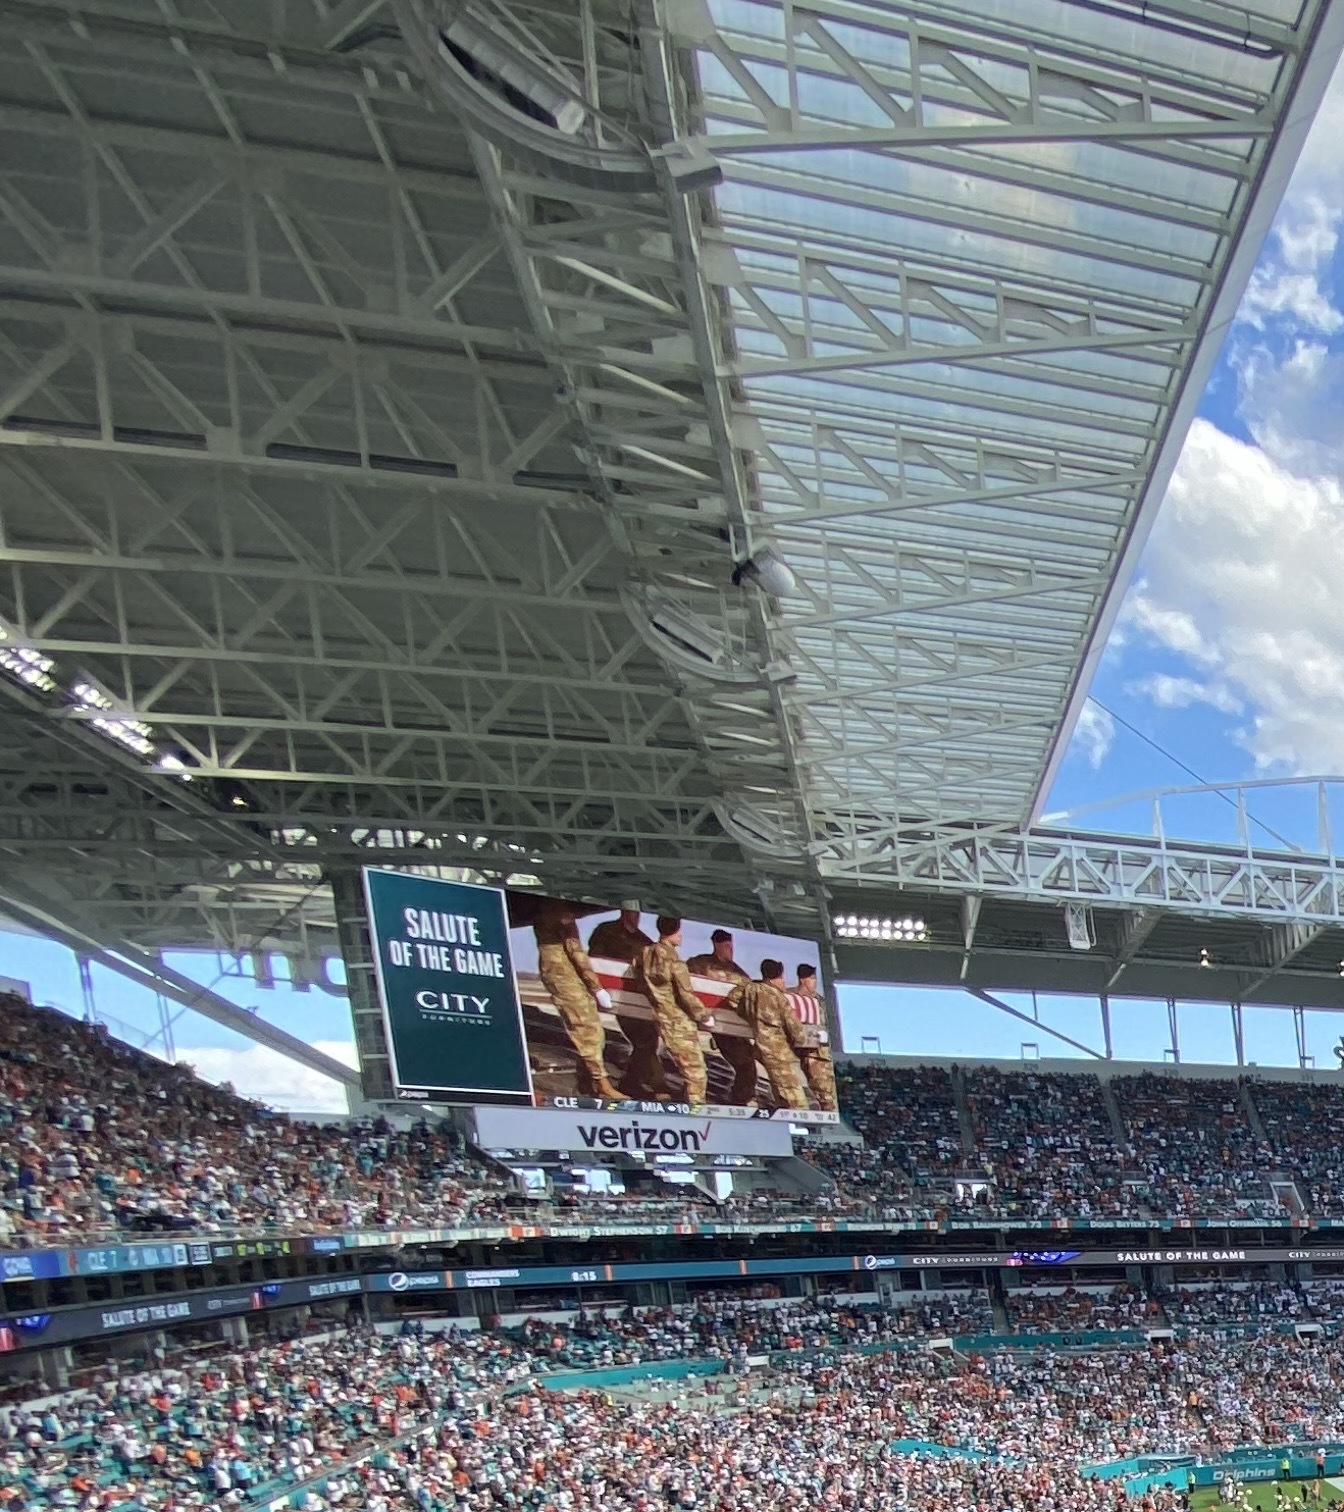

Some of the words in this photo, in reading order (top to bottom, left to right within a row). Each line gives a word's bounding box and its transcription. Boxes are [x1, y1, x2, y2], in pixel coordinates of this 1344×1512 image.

[405, 907, 481, 947] SALUTE
[389, 939, 413, 967] OF
[416, 943, 451, 973] THE
[454, 949, 504, 978] GAME
[416, 990, 491, 1014] CITY
[554, 1096, 578, 1108] CLE
[597, 1100, 603, 1110] 7
[641, 1102, 664, 1113] MIA
[677, 1104, 690, 1115] 10
[577, 1120, 700, 1151] verizon
[1117, 1252, 1162, 1261] SALUTE
[1166, 1252, 1182, 1260] OF
[1186, 1252, 1208, 1260] THE
[1212, 1251, 1245, 1260] GAME
[571, 1271, 597, 1282] 8:15
[1213, 1467, 1276, 1481] Dolphins
